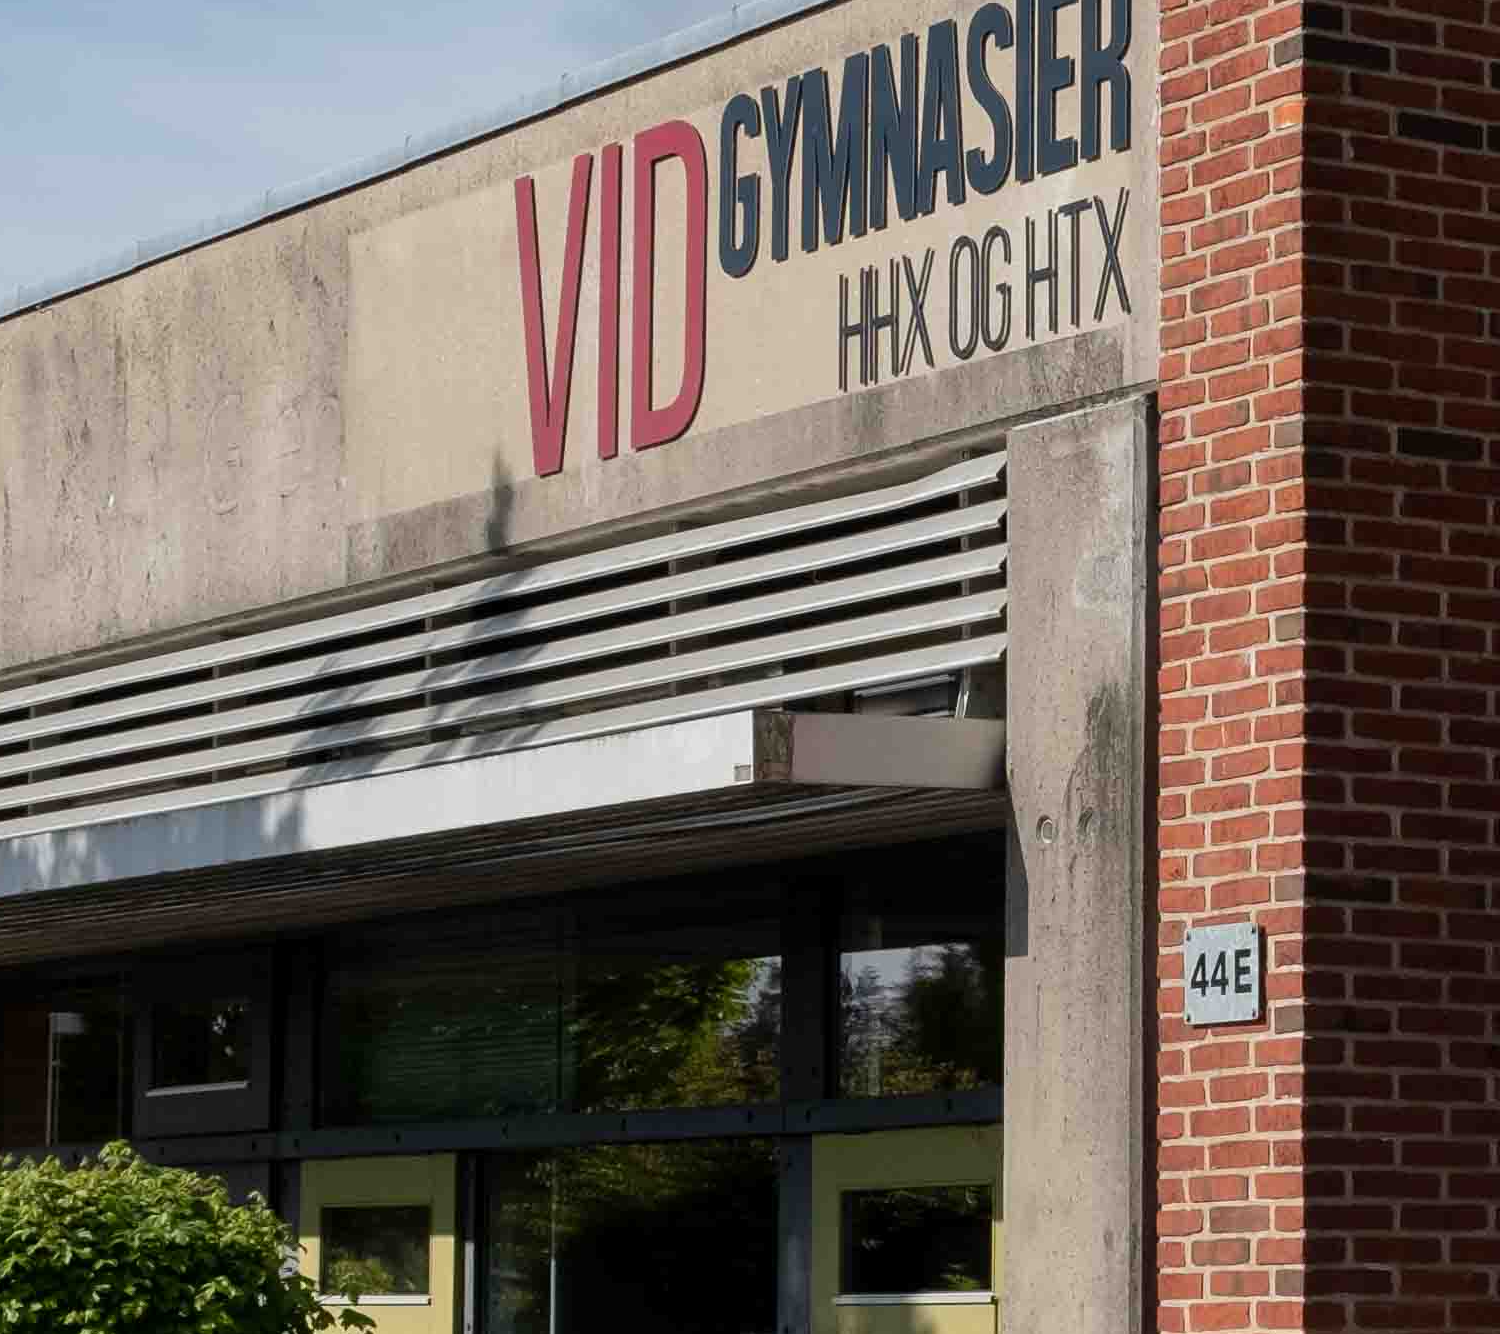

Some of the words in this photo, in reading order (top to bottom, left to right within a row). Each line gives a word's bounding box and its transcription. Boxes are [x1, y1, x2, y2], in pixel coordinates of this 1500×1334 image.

[514, 119, 708, 477] VID
[838, 248, 935, 392] HHX
[948, 225, 1012, 361] OG
[1024, 187, 1132, 340] HTX
[1190, 949, 1252, 997] 44E
